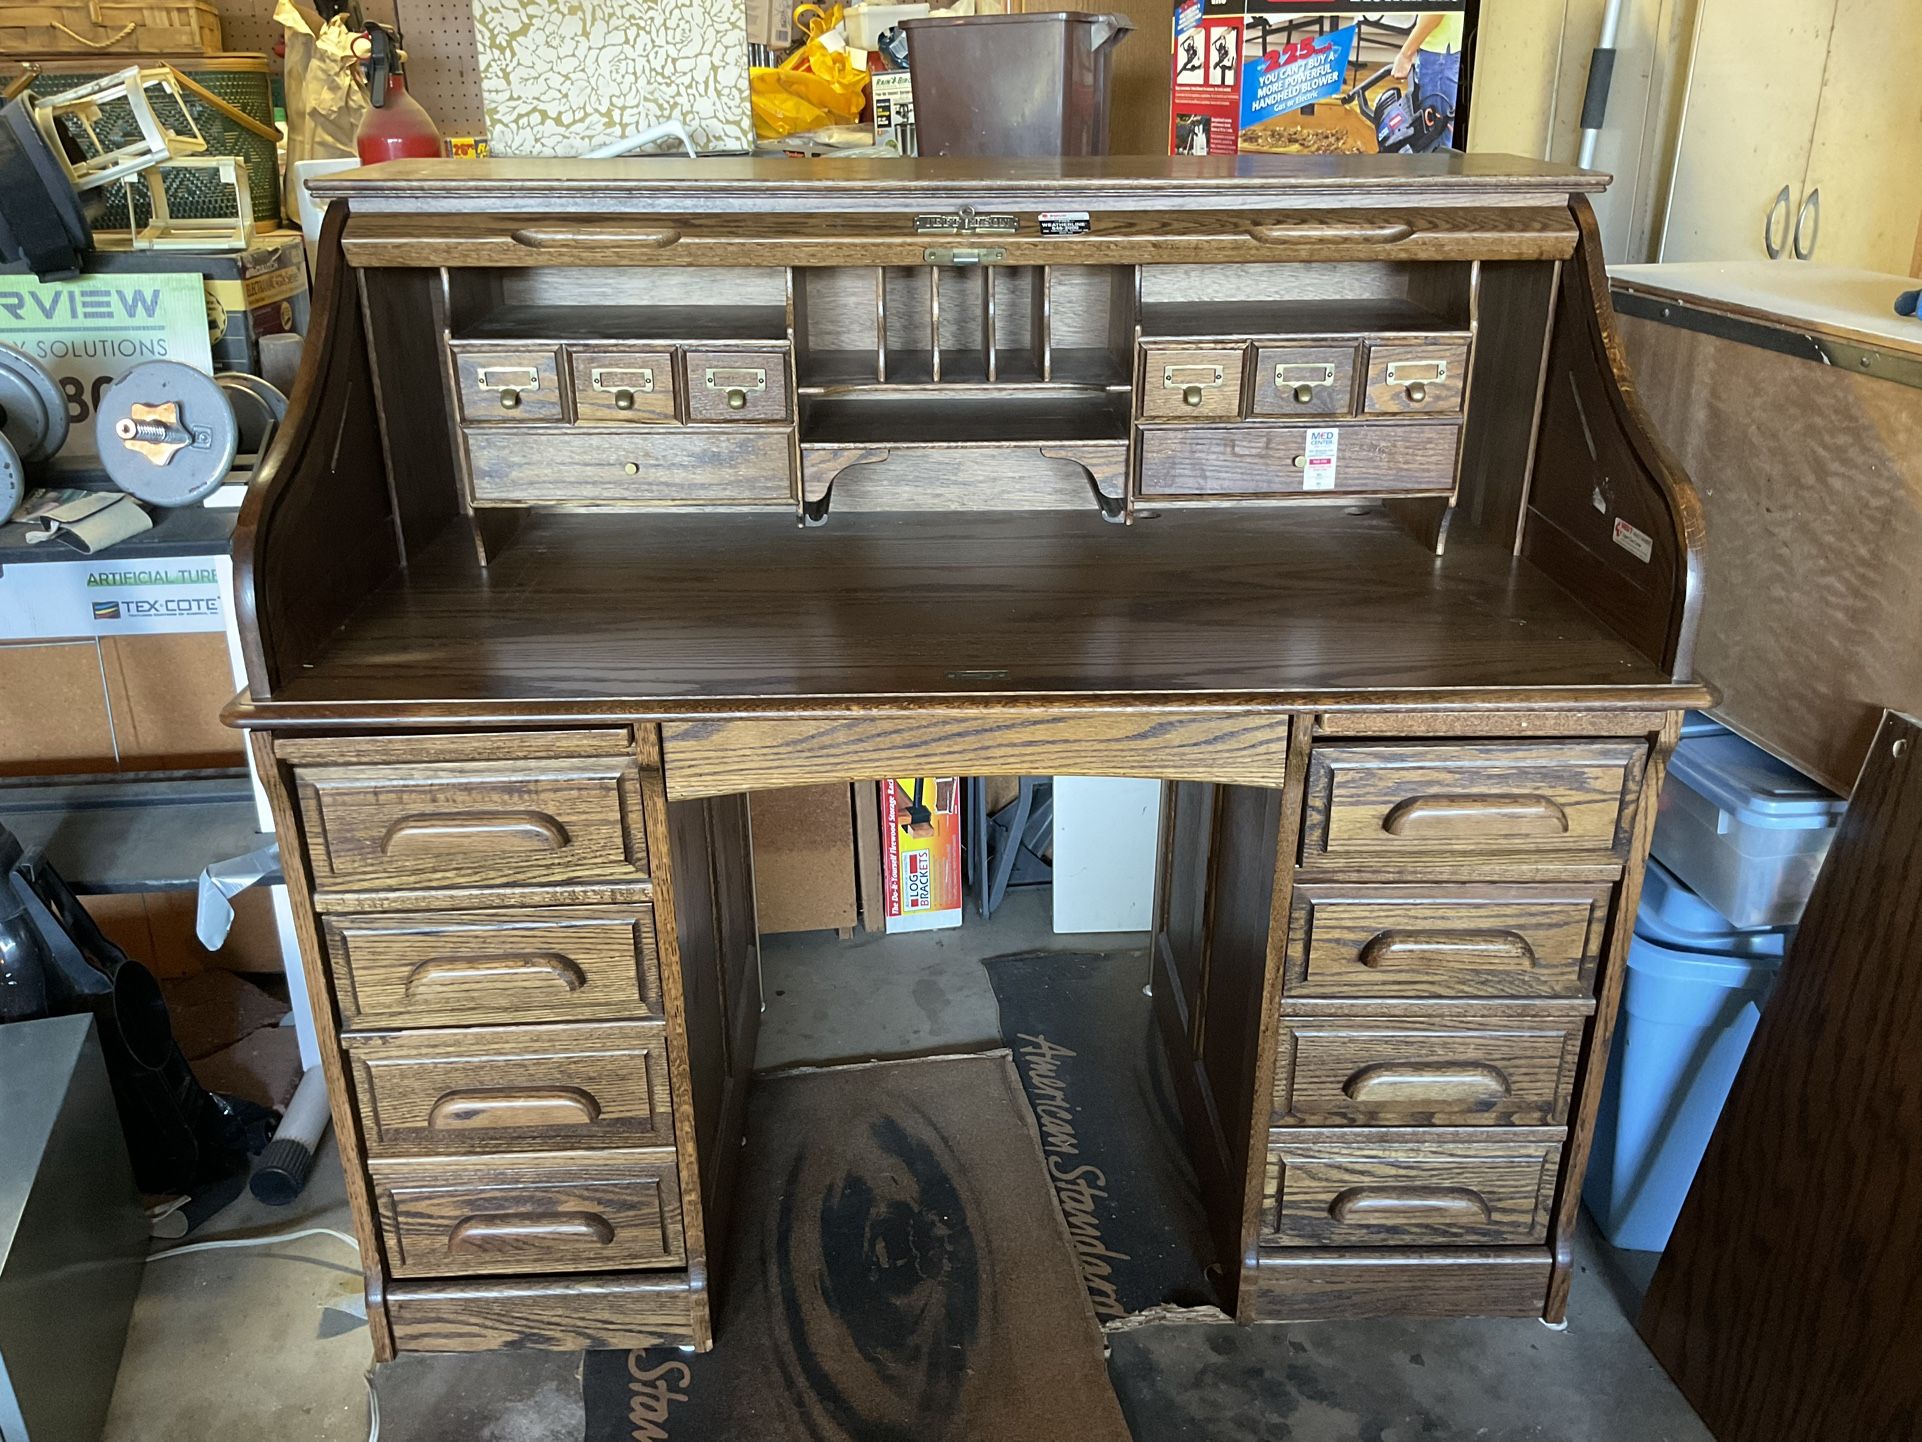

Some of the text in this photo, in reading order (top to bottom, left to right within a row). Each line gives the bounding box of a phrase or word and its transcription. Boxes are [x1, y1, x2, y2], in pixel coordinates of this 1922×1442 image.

[1264, 36, 1316, 73] 225
[1257, 64, 1332, 99] MORE POWERFUL
[1259, 72, 1278, 87] YOU
[1279, 63, 1306, 79] CAN'T
[1307, 53, 1328, 68] BUY
[1327, 51, 1335, 61] A
[1251, 72, 1339, 112] HANDHELD BLOWER
[1273, 101, 1286, 112] Gas
[1295, 91, 1319, 104] Electric
[925, 217, 1011, 227] JEFFRSON
[37, 338, 168, 358] SOLUTIONS
[1311, 431, 1334, 440] MED
[87, 570, 172, 586] ARTIFICIAL
[888, 796, 896, 822] Storage
[889, 823, 897, 854] Firewood
[909, 874, 919, 898] LOG
[918, 852, 929, 906] BRACKETS
[891, 902, 899, 914] The
[1016, 1033, 1081, 1155] American
